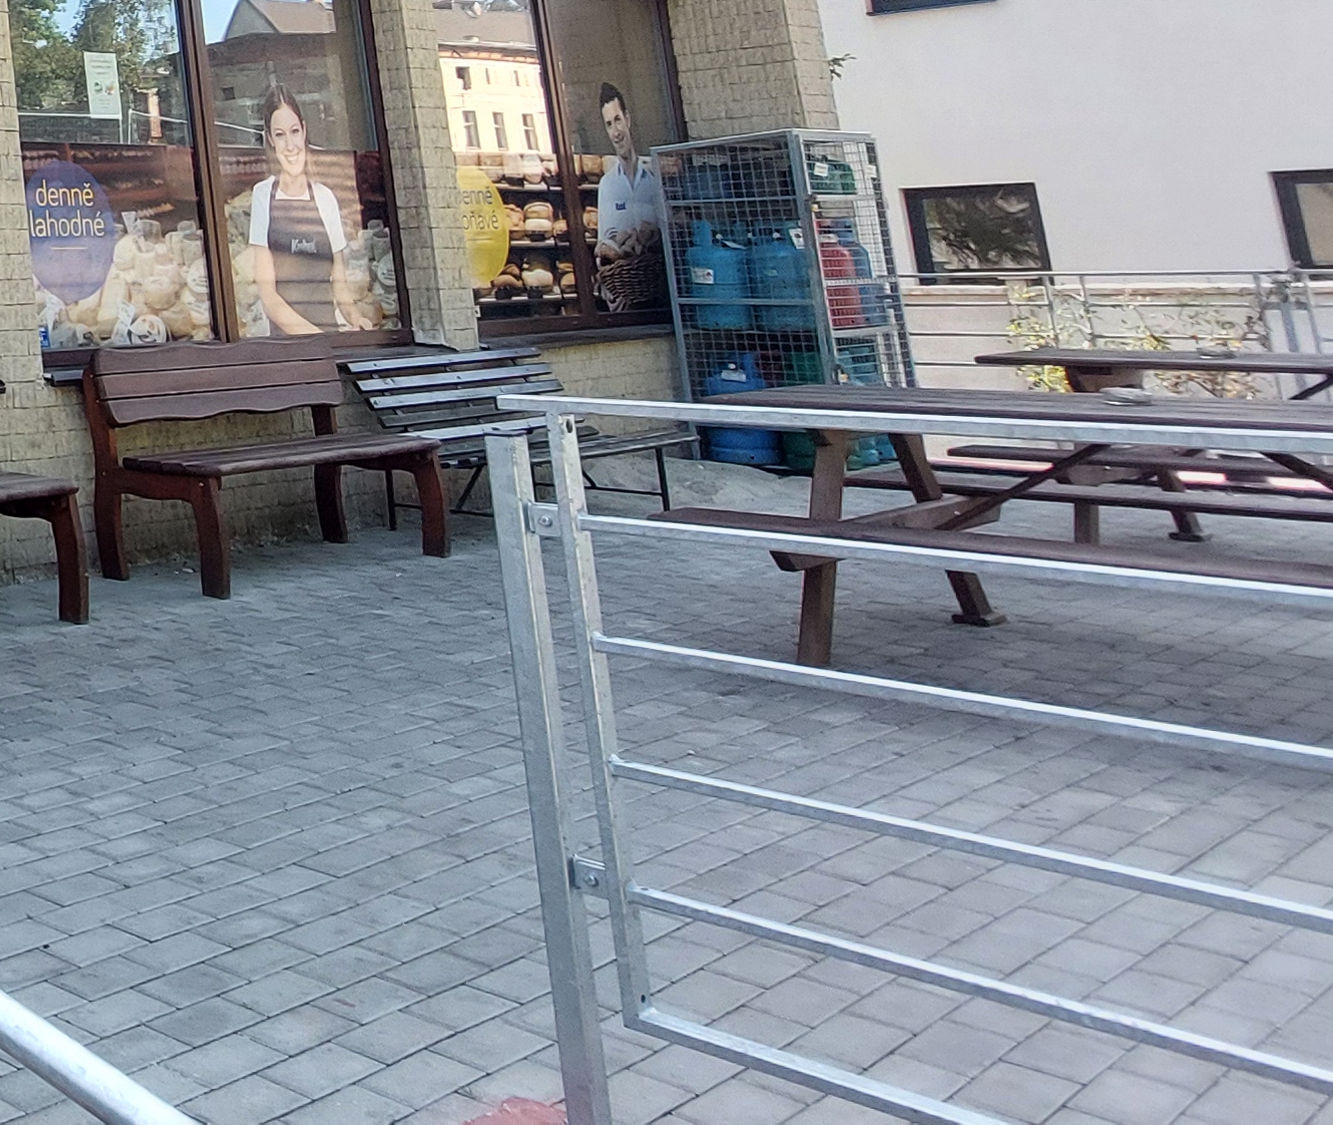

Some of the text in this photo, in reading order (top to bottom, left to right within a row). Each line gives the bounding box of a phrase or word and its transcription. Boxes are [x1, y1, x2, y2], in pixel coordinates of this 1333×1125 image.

[35, 179, 94, 207] denně
[461, 186, 493, 205] enně
[29, 209, 105, 237] lahodné
[461, 210, 499, 230] oňavé
